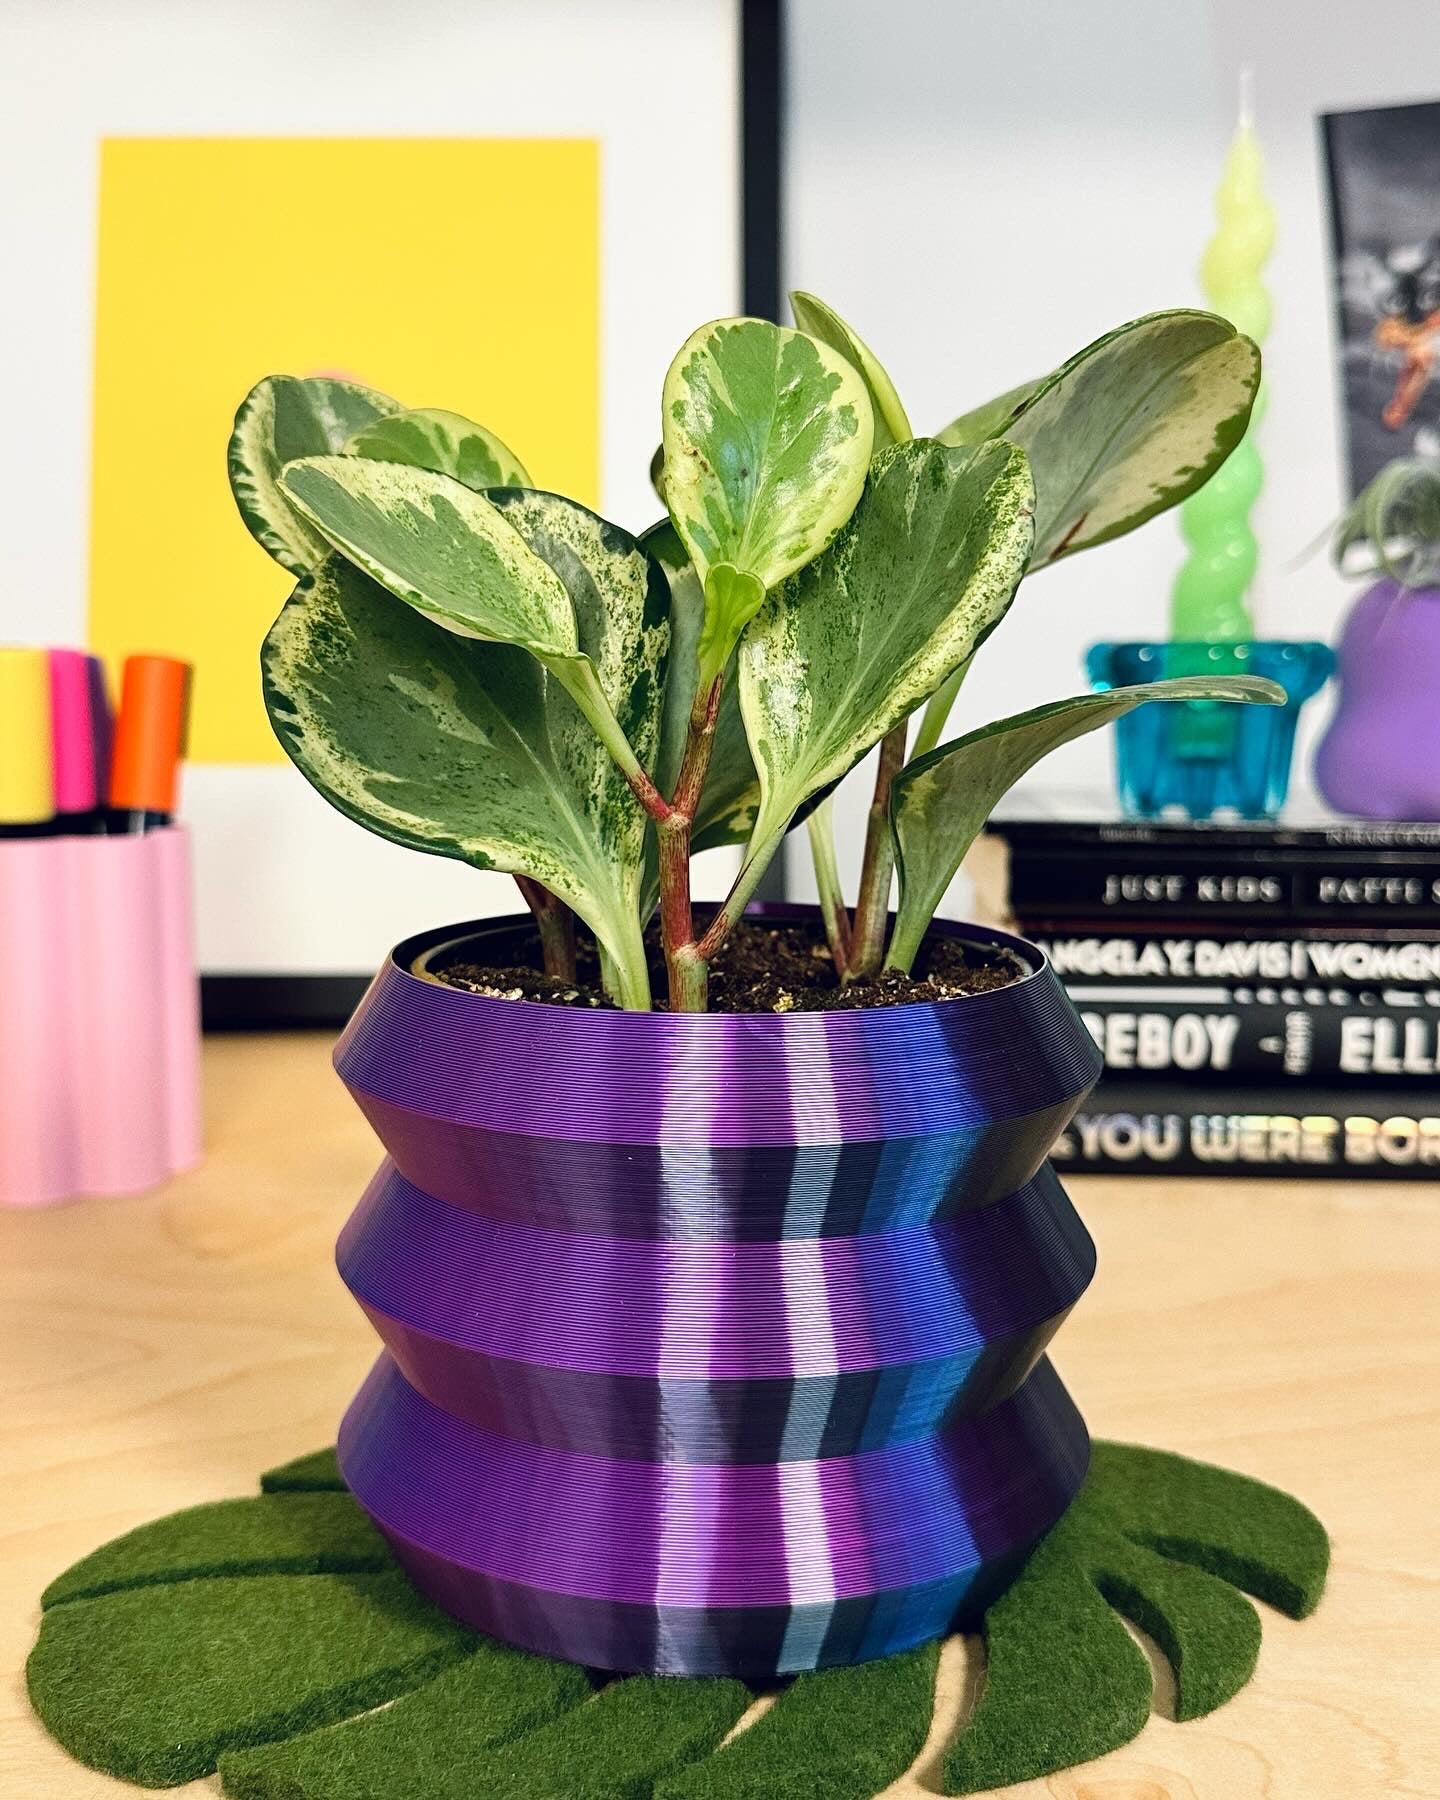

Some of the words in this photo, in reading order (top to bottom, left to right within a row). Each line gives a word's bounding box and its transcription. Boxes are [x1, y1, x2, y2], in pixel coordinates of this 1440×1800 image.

[1103, 874, 1184, 905] JUST
[1198, 875, 1282, 903] KIDS
[1194, 940, 1290, 979] DAVIS
[1073, 1112, 1182, 1162] YOU
[1190, 1114, 1340, 1164] WERE
